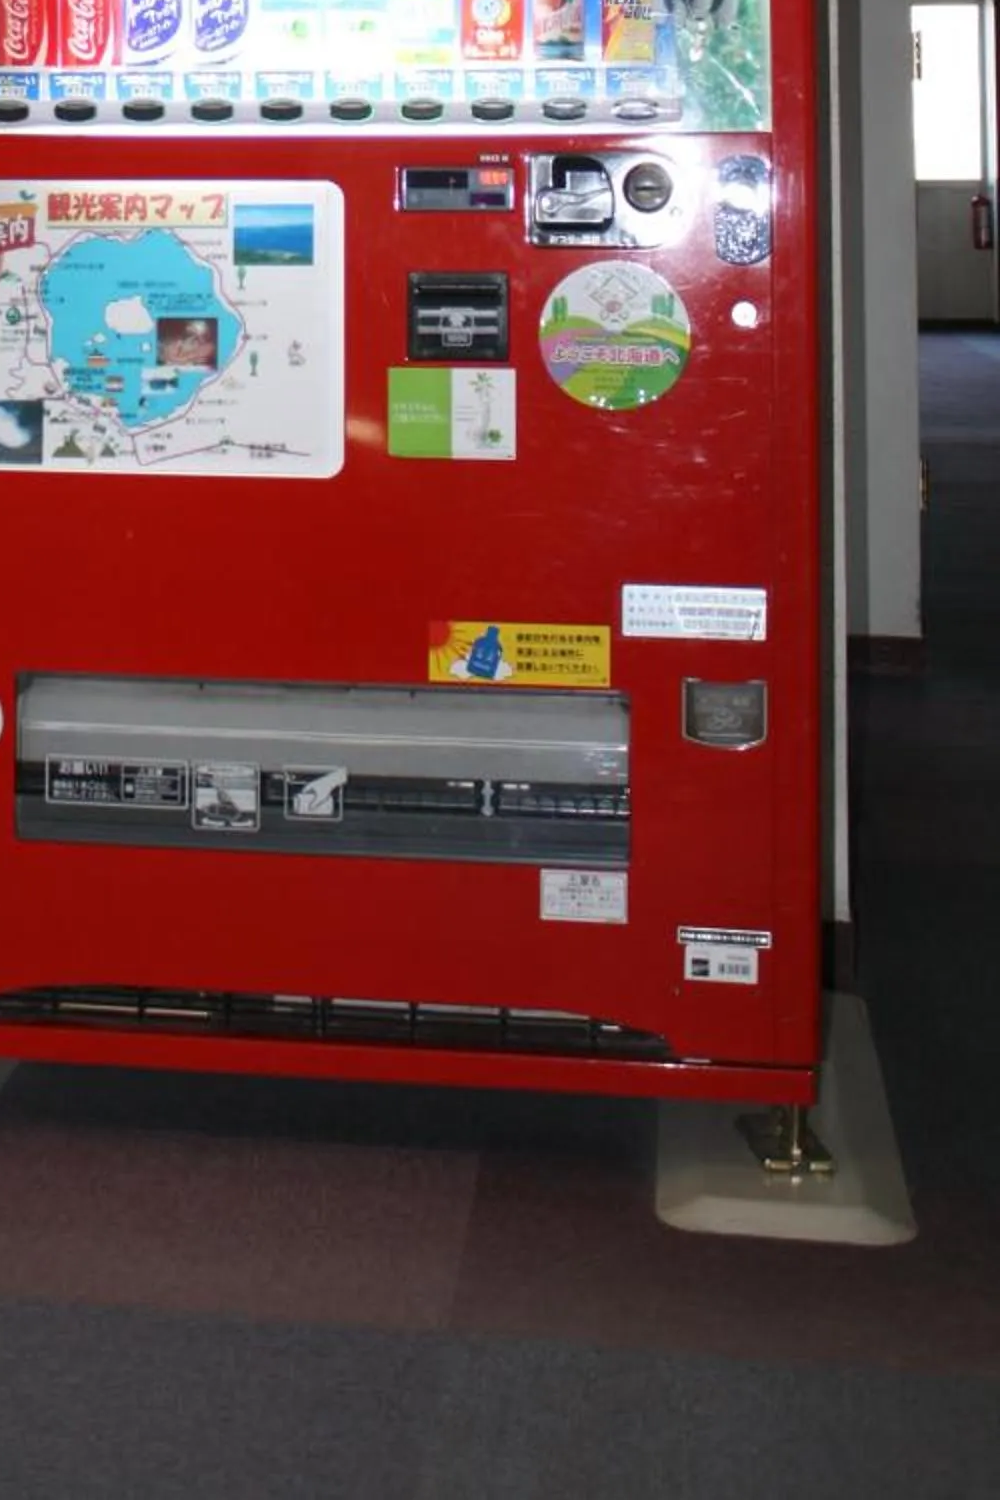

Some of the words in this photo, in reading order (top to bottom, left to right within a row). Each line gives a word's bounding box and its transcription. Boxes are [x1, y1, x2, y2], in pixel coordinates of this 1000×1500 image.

[47, 193, 226, 222] 観光案内マップ
